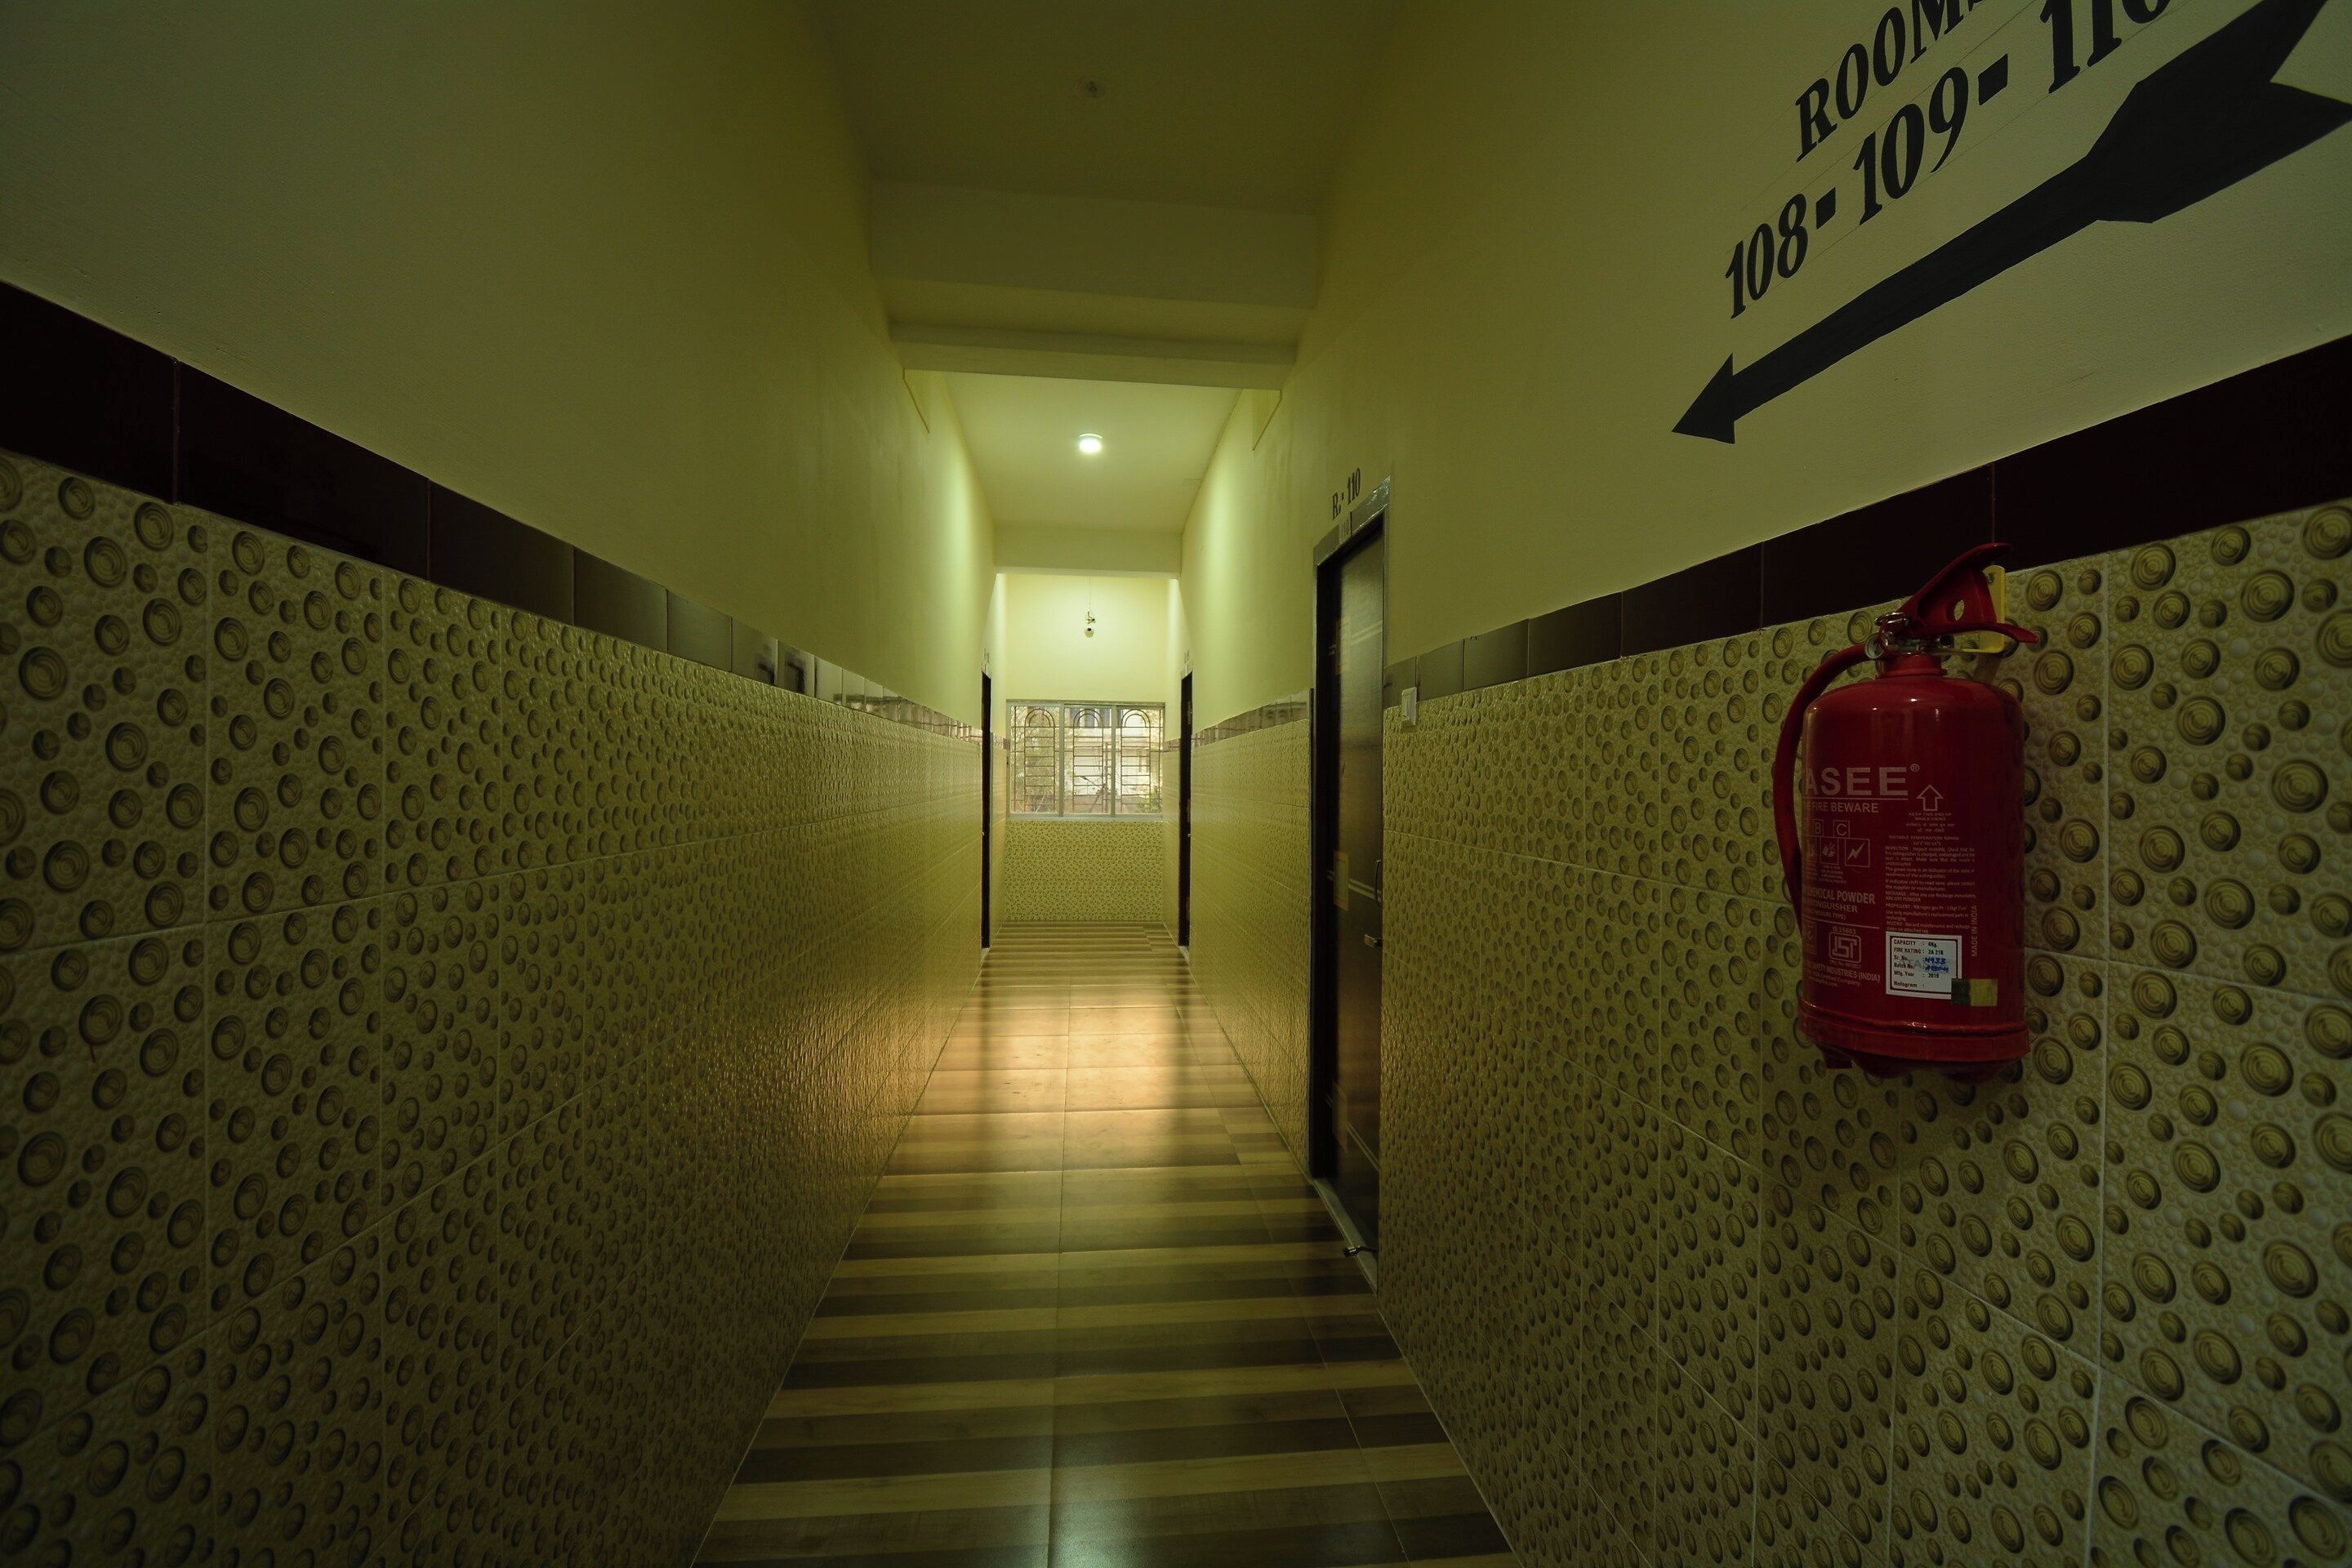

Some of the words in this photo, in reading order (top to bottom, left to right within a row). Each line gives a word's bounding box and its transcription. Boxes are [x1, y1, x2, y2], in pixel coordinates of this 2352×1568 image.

[1796, 0, 1984, 163] ROOM
[1830, 802, 1879, 813] BEWARE
[1836, 823, 1848, 836] C
[1837, 890, 1876, 904] POWDER
[1859, 971, 1880, 984] (INDIA)
